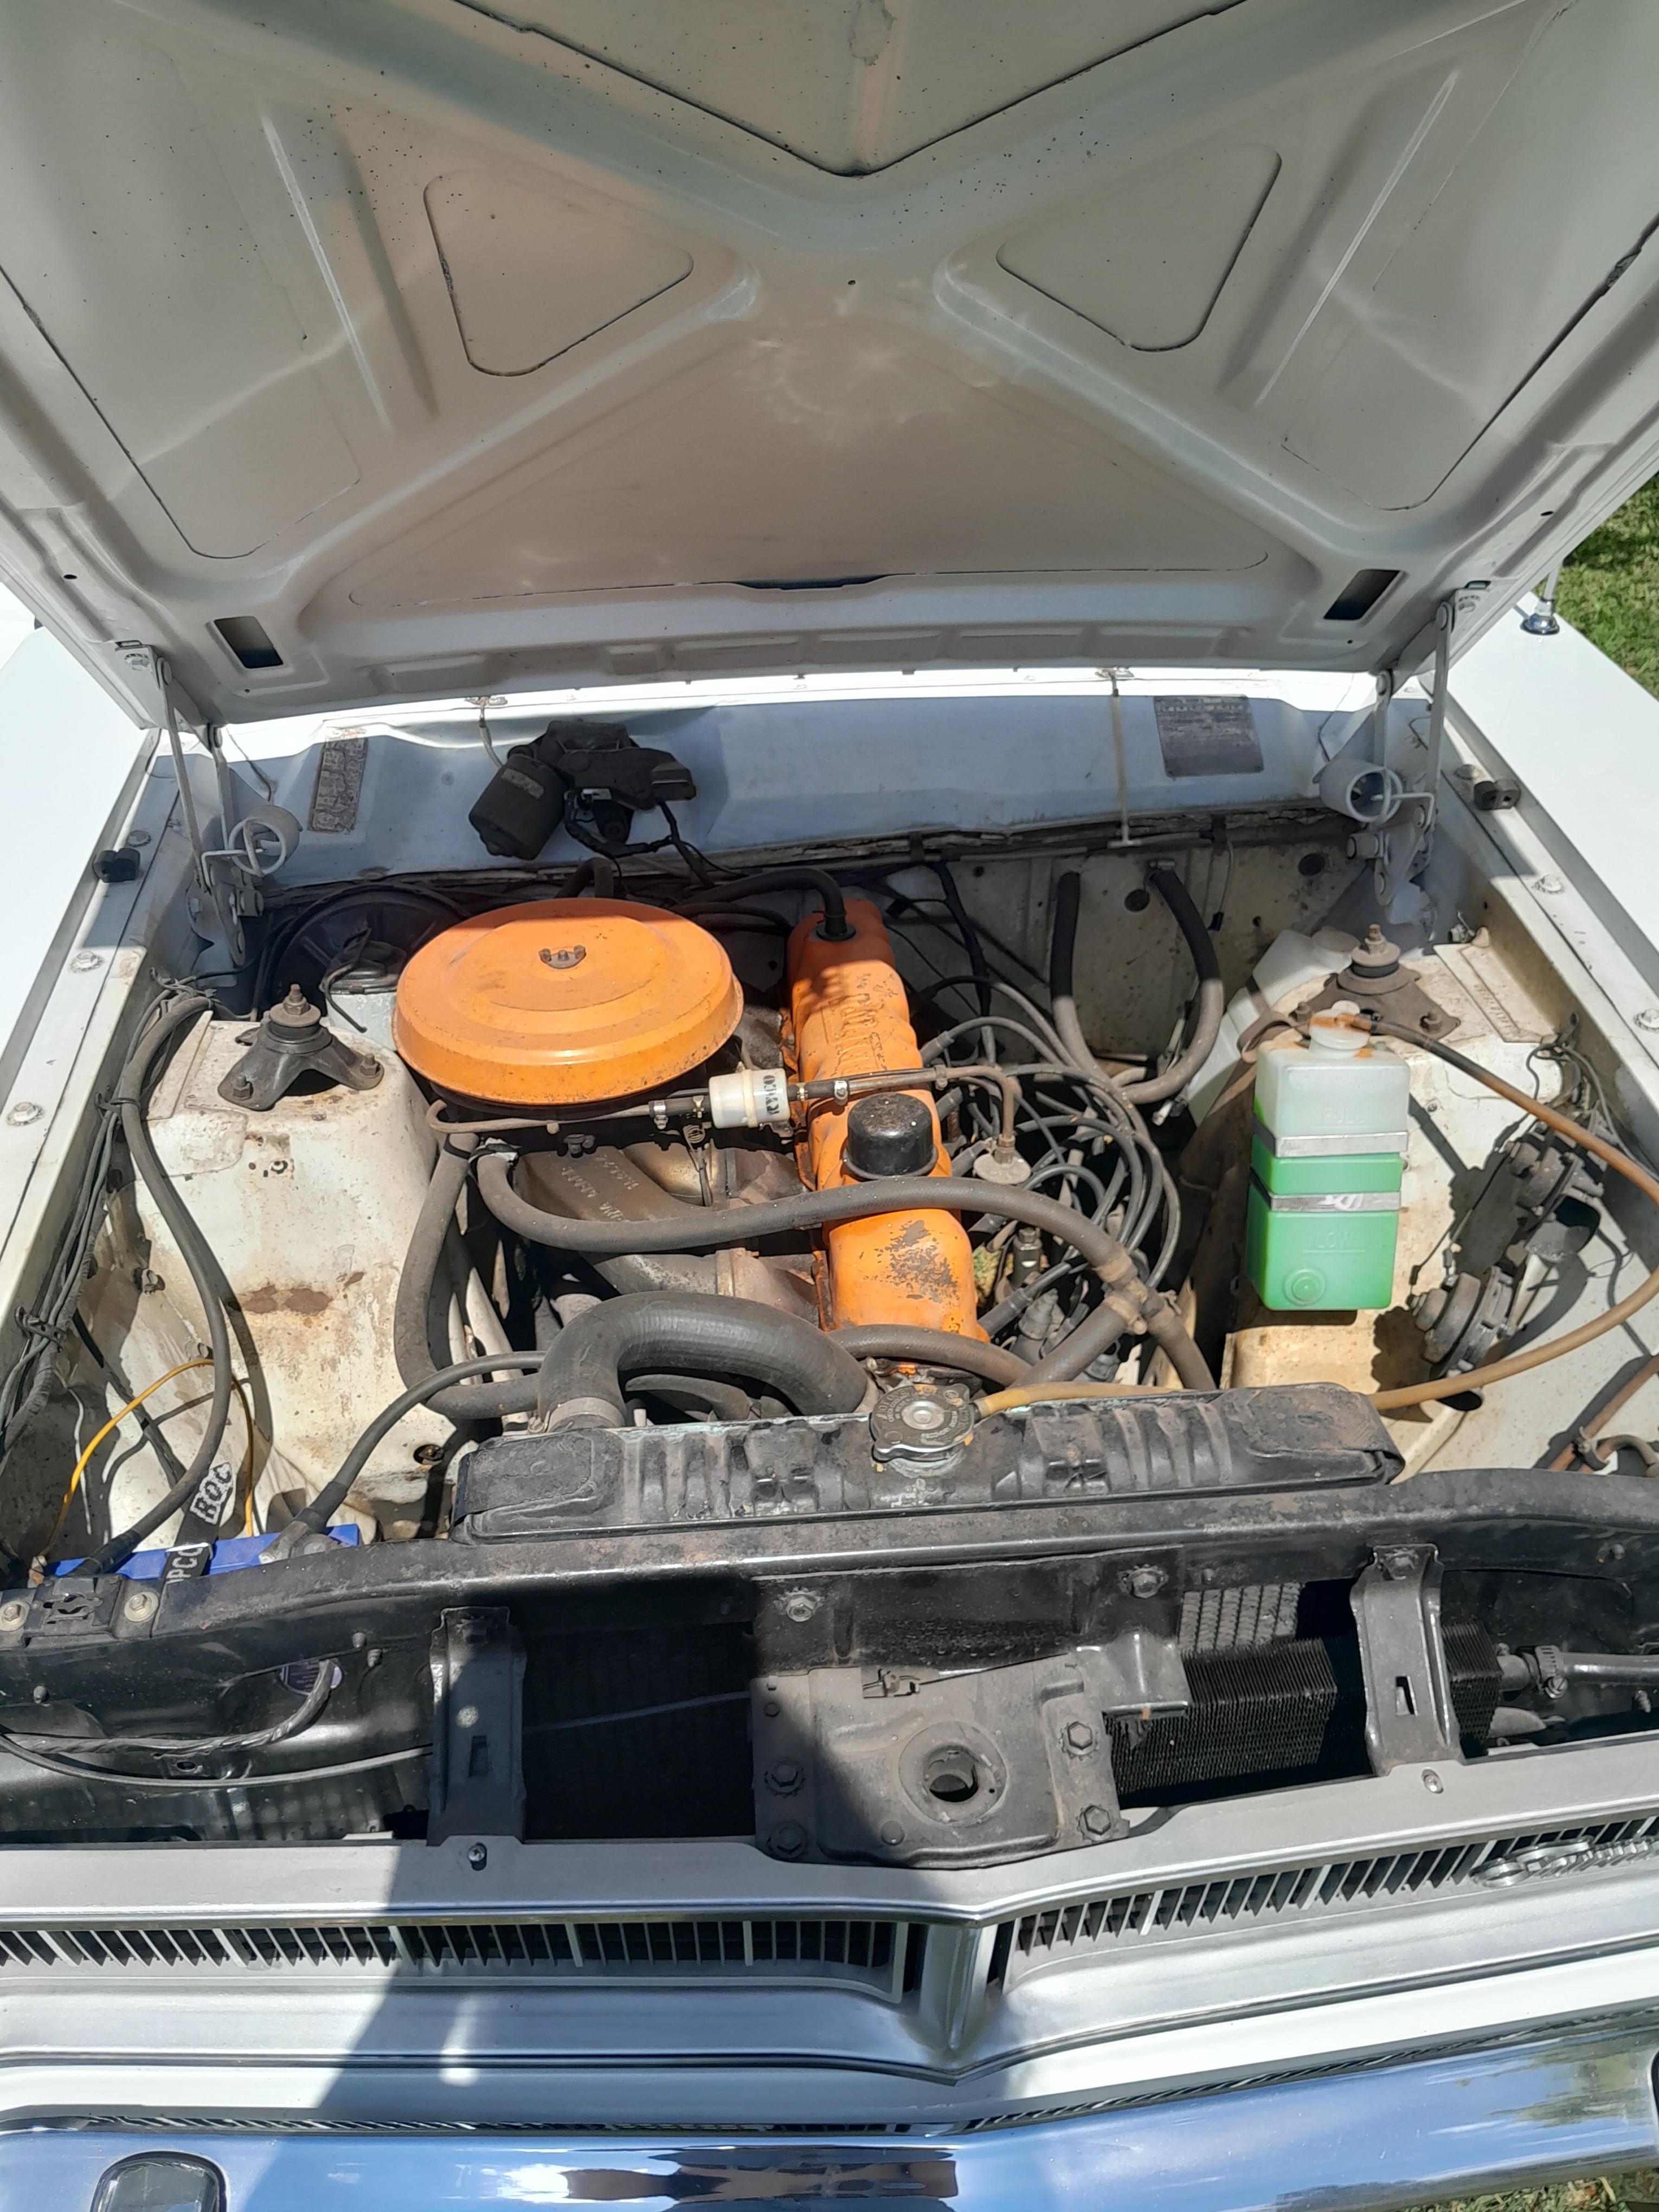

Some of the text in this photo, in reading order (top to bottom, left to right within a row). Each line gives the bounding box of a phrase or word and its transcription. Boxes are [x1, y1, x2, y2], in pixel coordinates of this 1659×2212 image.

[763, 1075, 780, 1115] RYCO
[1323, 1106, 1365, 1124] FULL
[1316, 1231, 1353, 1249] LOW
